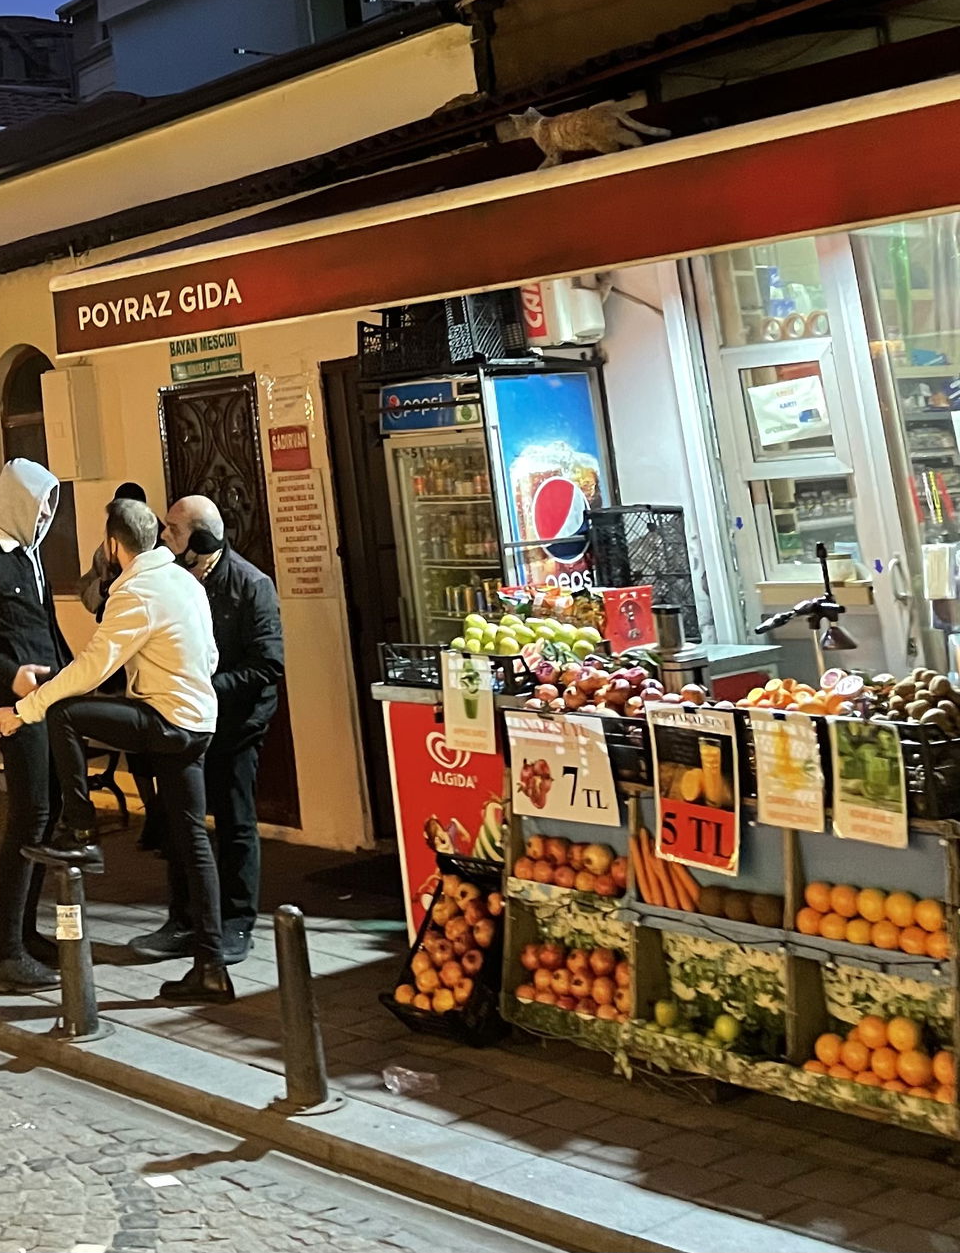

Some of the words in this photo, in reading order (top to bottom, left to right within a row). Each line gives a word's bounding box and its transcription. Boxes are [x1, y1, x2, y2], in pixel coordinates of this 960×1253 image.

[78, 290, 172, 330] POYRAZ
[179, 278, 242, 313] GIDA
[169, 338, 198, 356] BAYAN
[561, 766, 578, 806] 7
[582, 789, 609, 809] TL
[662, 812, 677, 845] 5
[688, 817, 732, 859] TL
